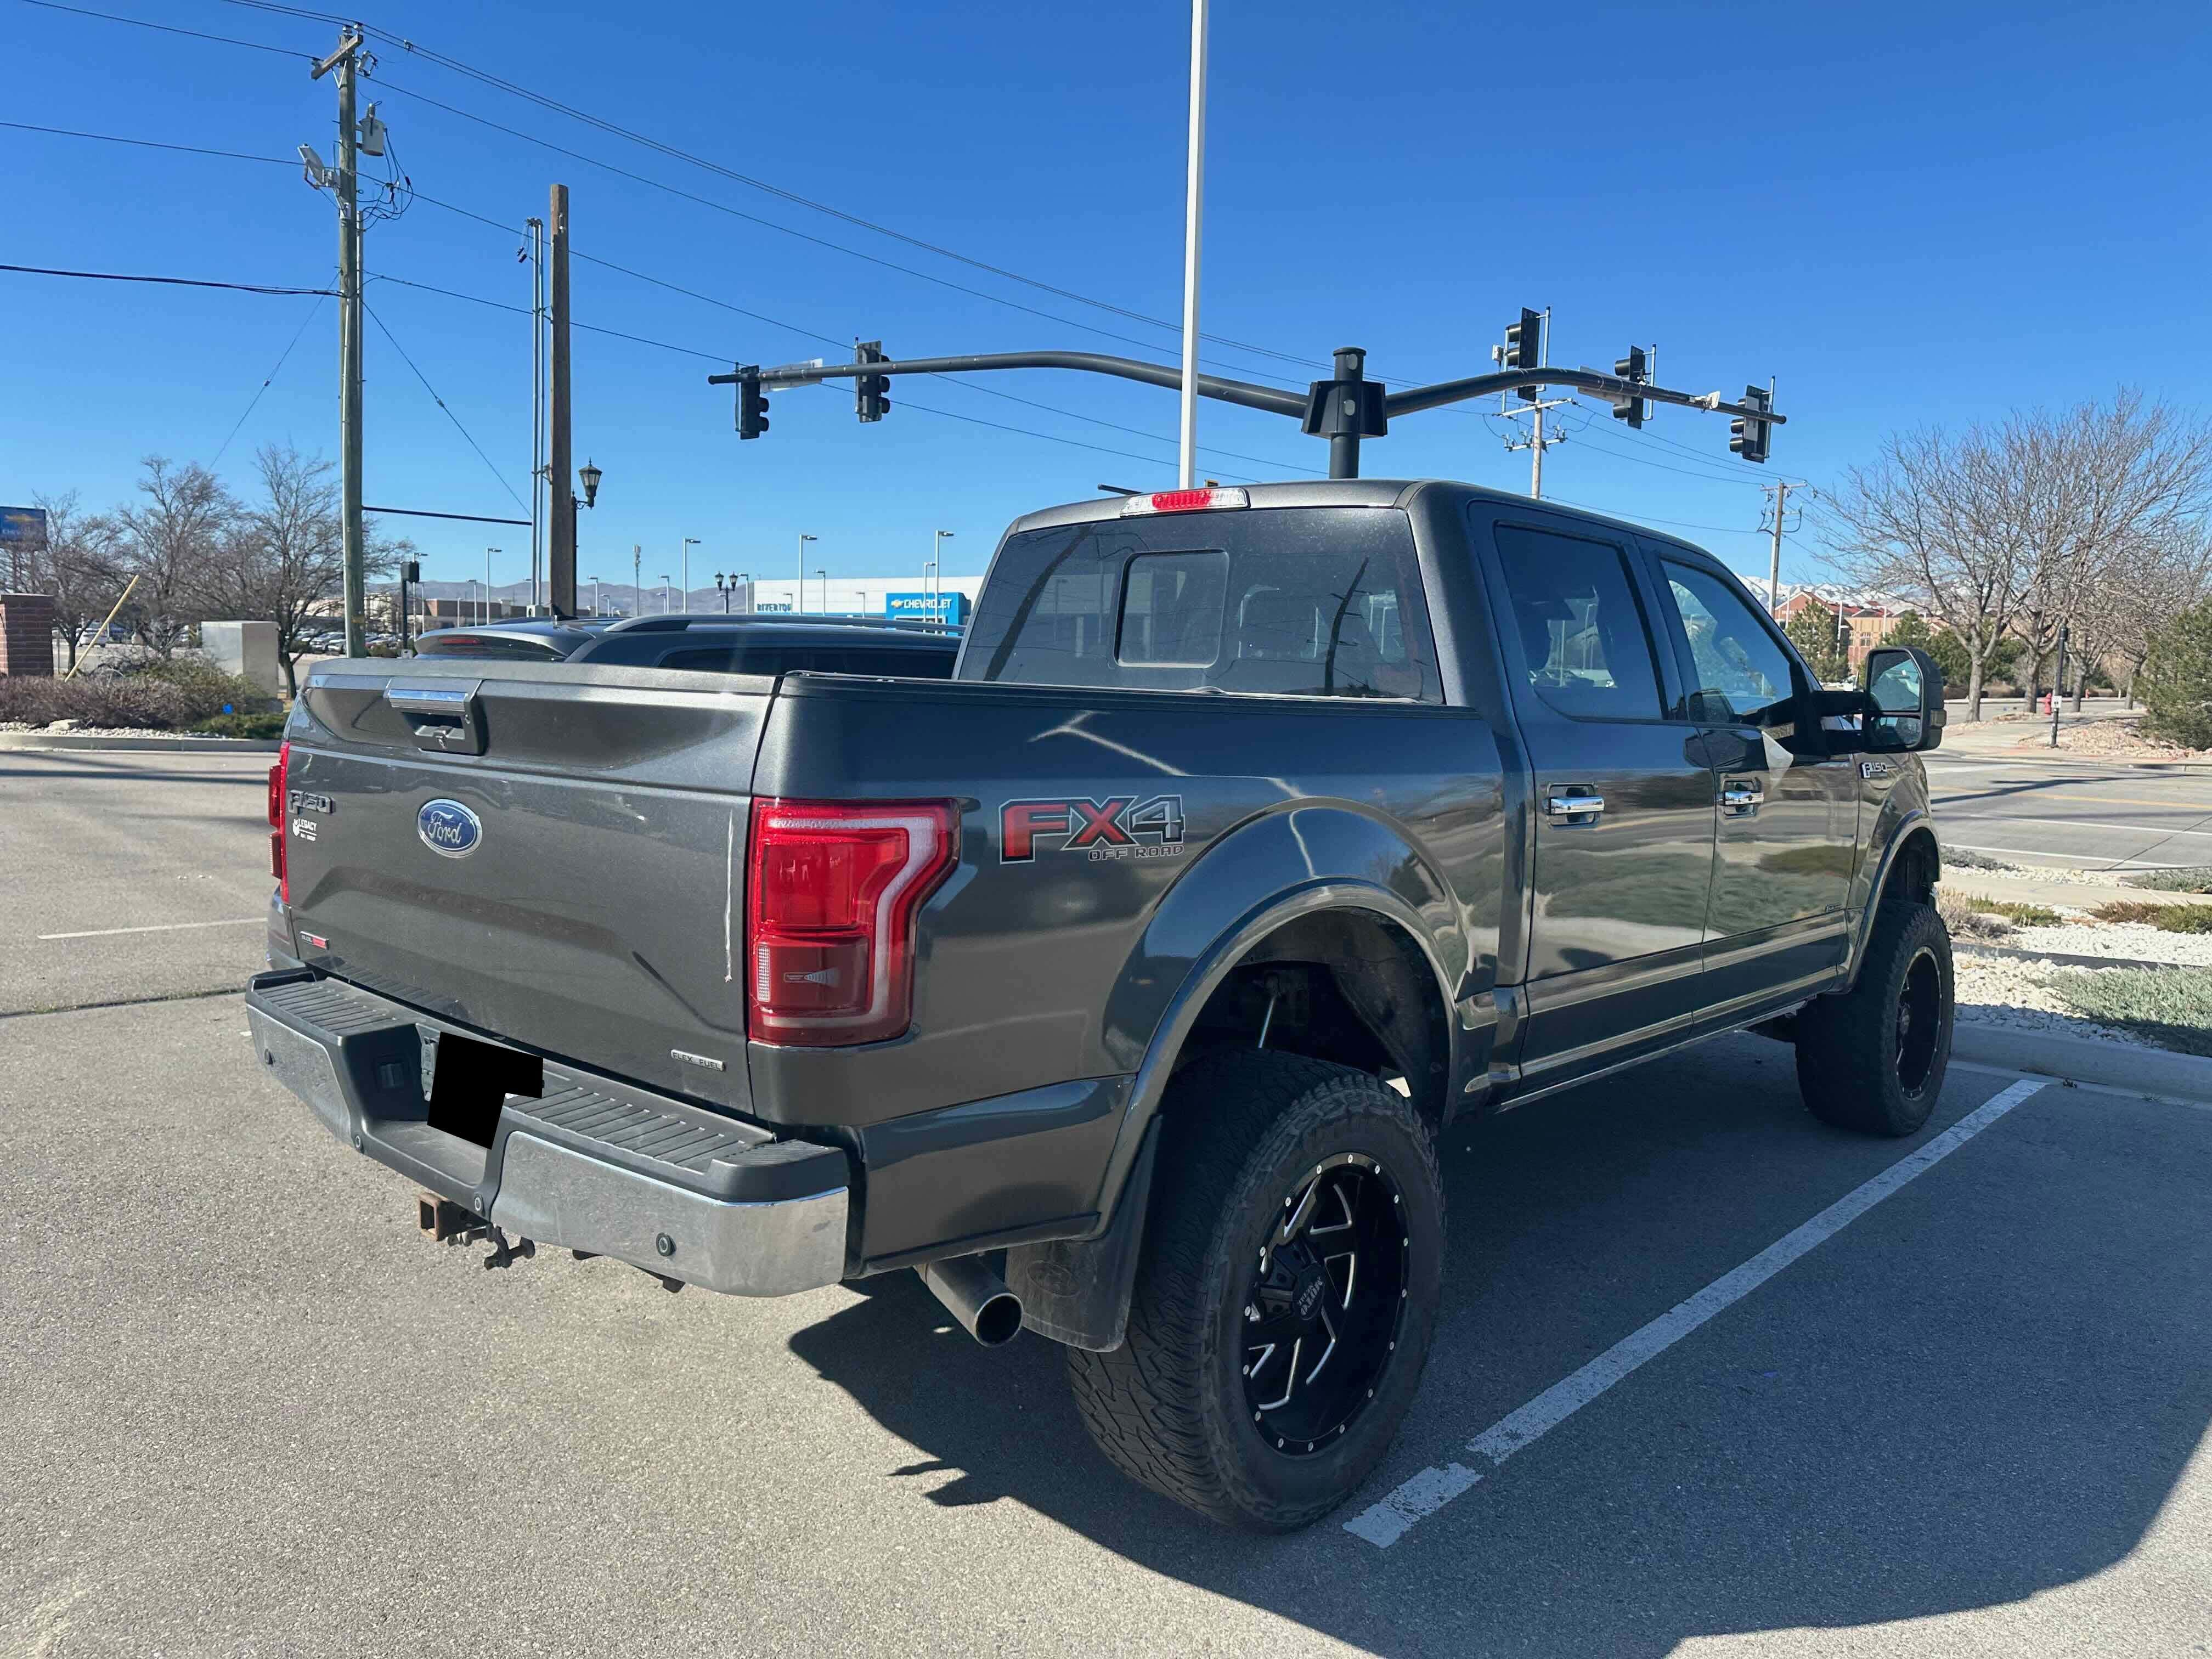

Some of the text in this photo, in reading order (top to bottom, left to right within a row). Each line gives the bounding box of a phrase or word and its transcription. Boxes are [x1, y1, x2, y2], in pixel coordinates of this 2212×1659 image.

[904, 599, 952, 609] CHEVROLET
[298, 818, 317, 832] LEGACY
[428, 810, 462, 844] Ford
[999, 794, 1186, 865] FX4
[1088, 844, 1185, 862] OFF ROAD
[672, 1051, 721, 1070] FLEX FUEL
